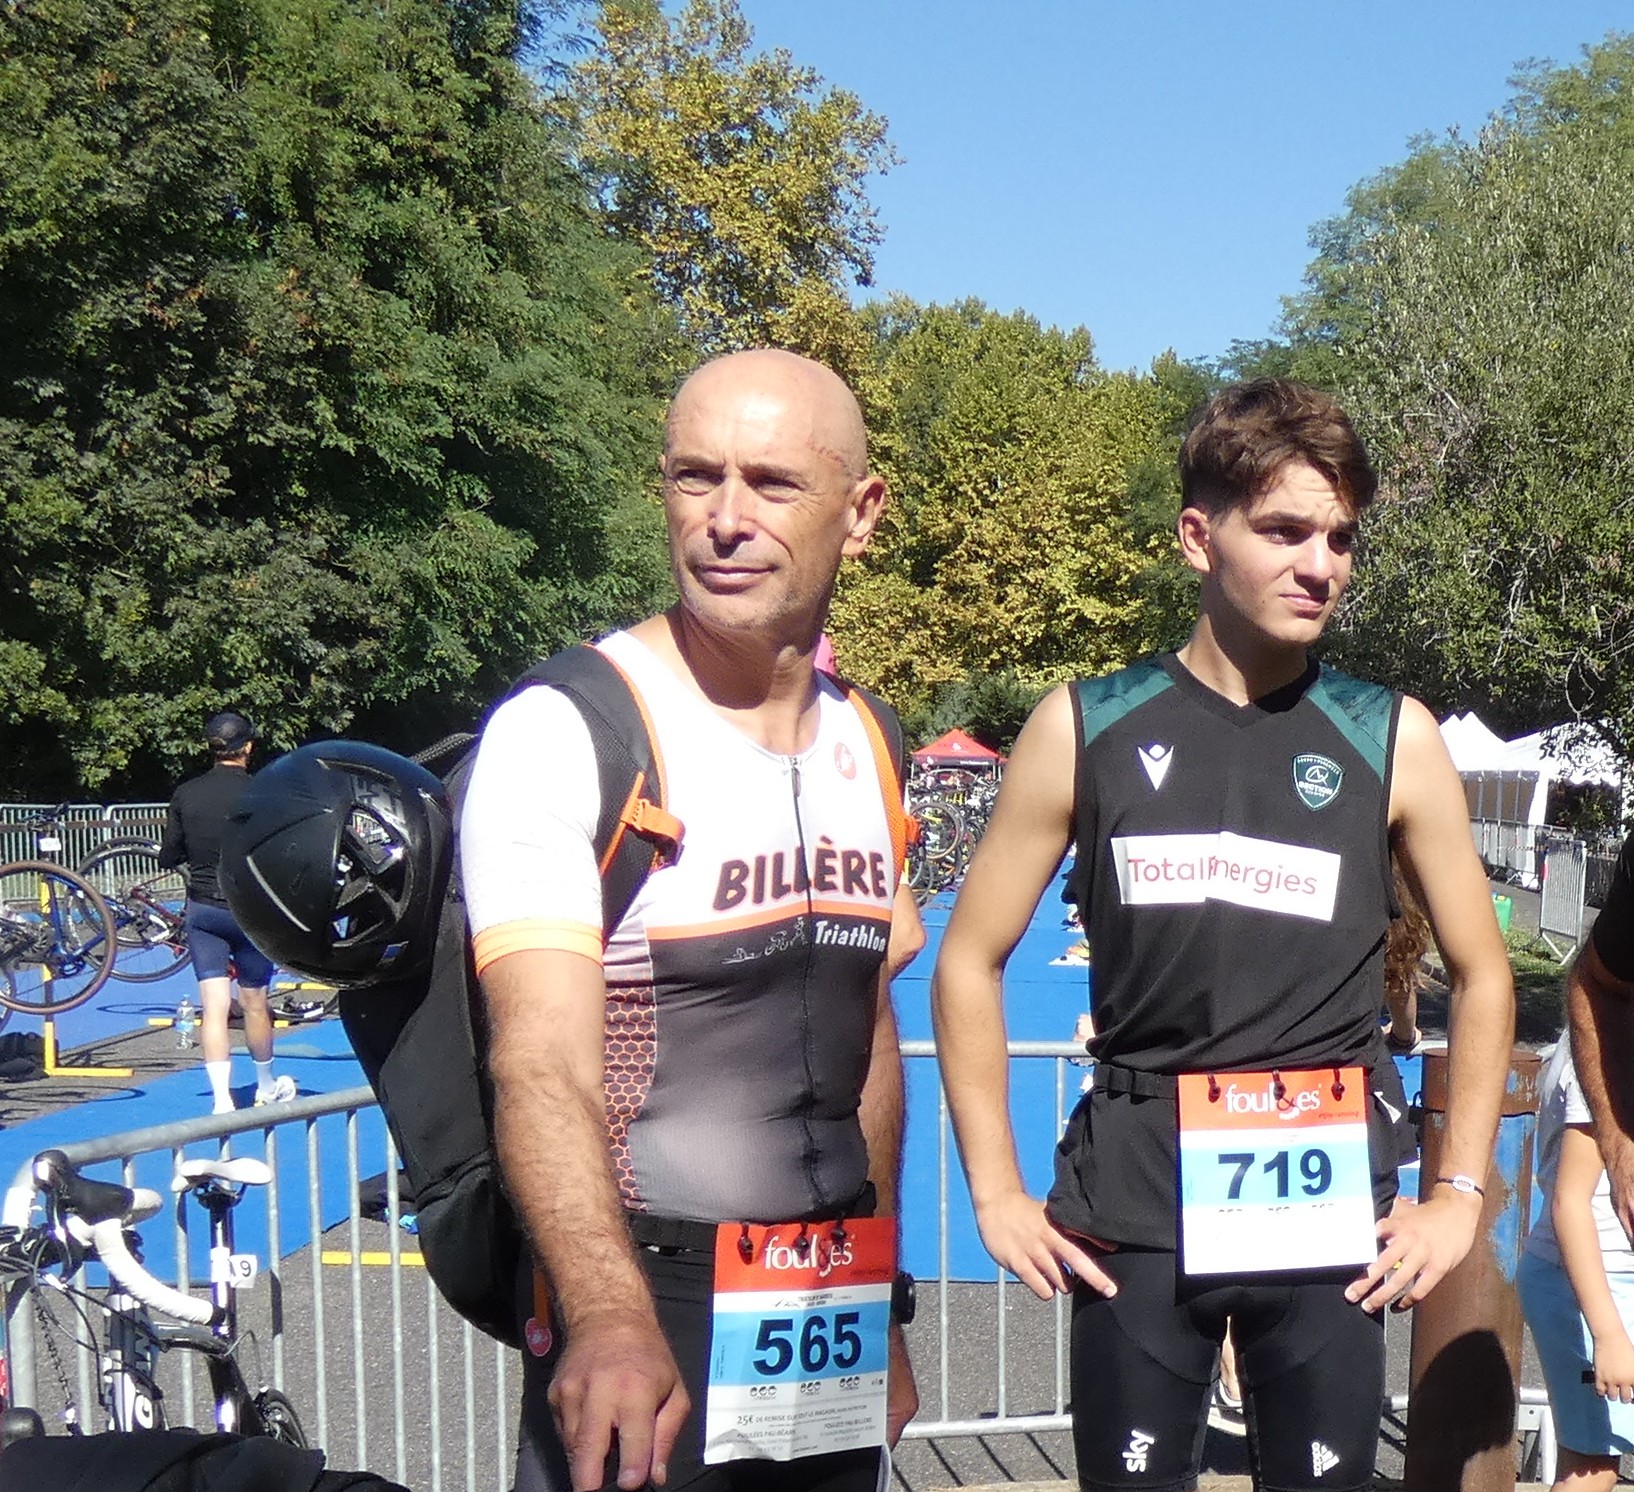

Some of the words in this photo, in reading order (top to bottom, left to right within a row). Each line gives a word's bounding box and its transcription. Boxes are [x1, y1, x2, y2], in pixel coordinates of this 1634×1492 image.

[712, 835, 887, 912] BILLÈRE
[815, 920, 886, 953] Triathlon
[1218, 1148, 1333, 1200] 719
[752, 1311, 862, 1377] 565
[1122, 1429, 1155, 1473] sky
